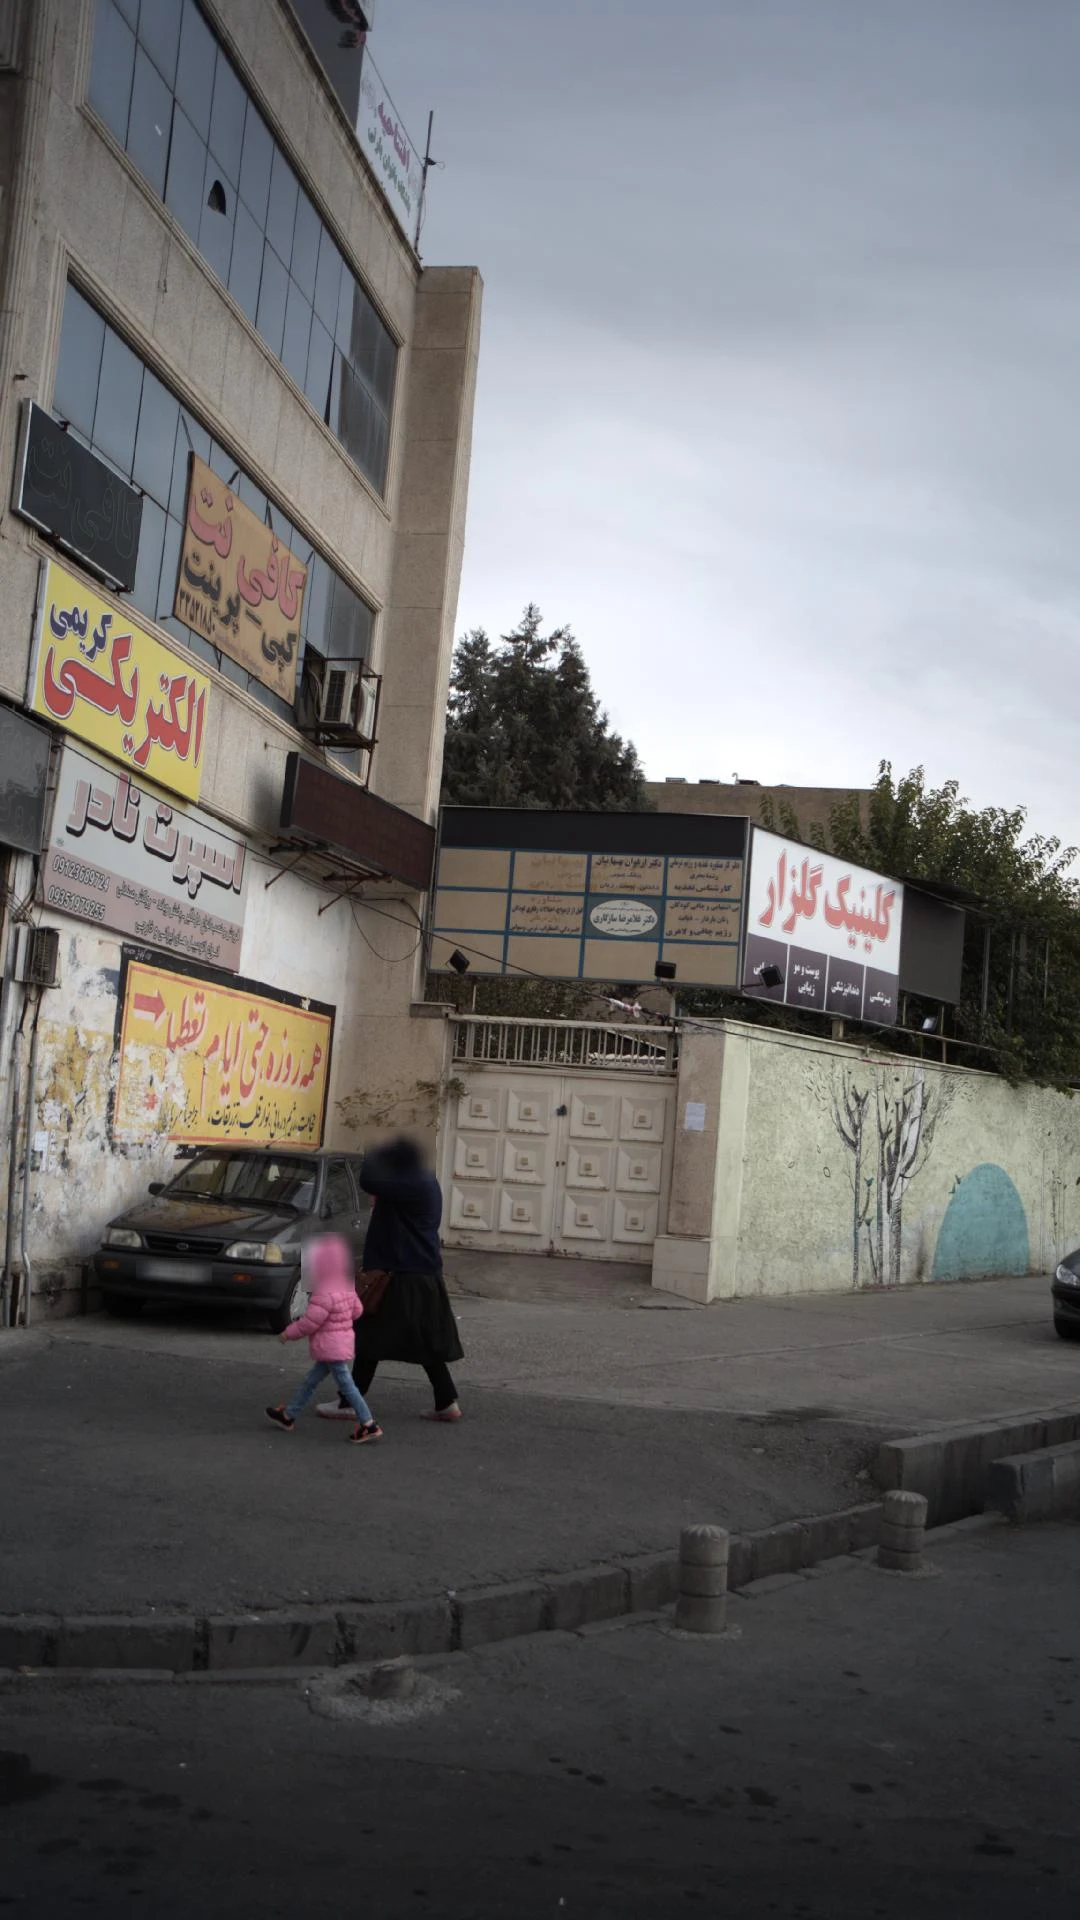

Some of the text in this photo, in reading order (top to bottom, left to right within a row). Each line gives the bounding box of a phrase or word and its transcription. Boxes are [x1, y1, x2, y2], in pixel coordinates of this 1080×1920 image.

[188, 487, 307, 620] کافی نت
[184, 551, 242, 635] پرینت
[49, 602, 112, 661] کریمی
[261, 629, 297, 671] کپی
[43, 634, 207, 768] الکتریکی
[65, 771, 142, 842] نادر
[143, 800, 247, 899] اسپرت
[641, 914, 656, 926] دکتر
[759, 851, 897, 952] گلزار کلینیک
[797, 981, 816, 997] زیبایی
[805, 964, 820, 980] پوست
[830, 980, 861, 998] دندانپزشکی
[869, 990, 893, 1007] پزشکی
[240, 1009, 270, 1100] حتی
